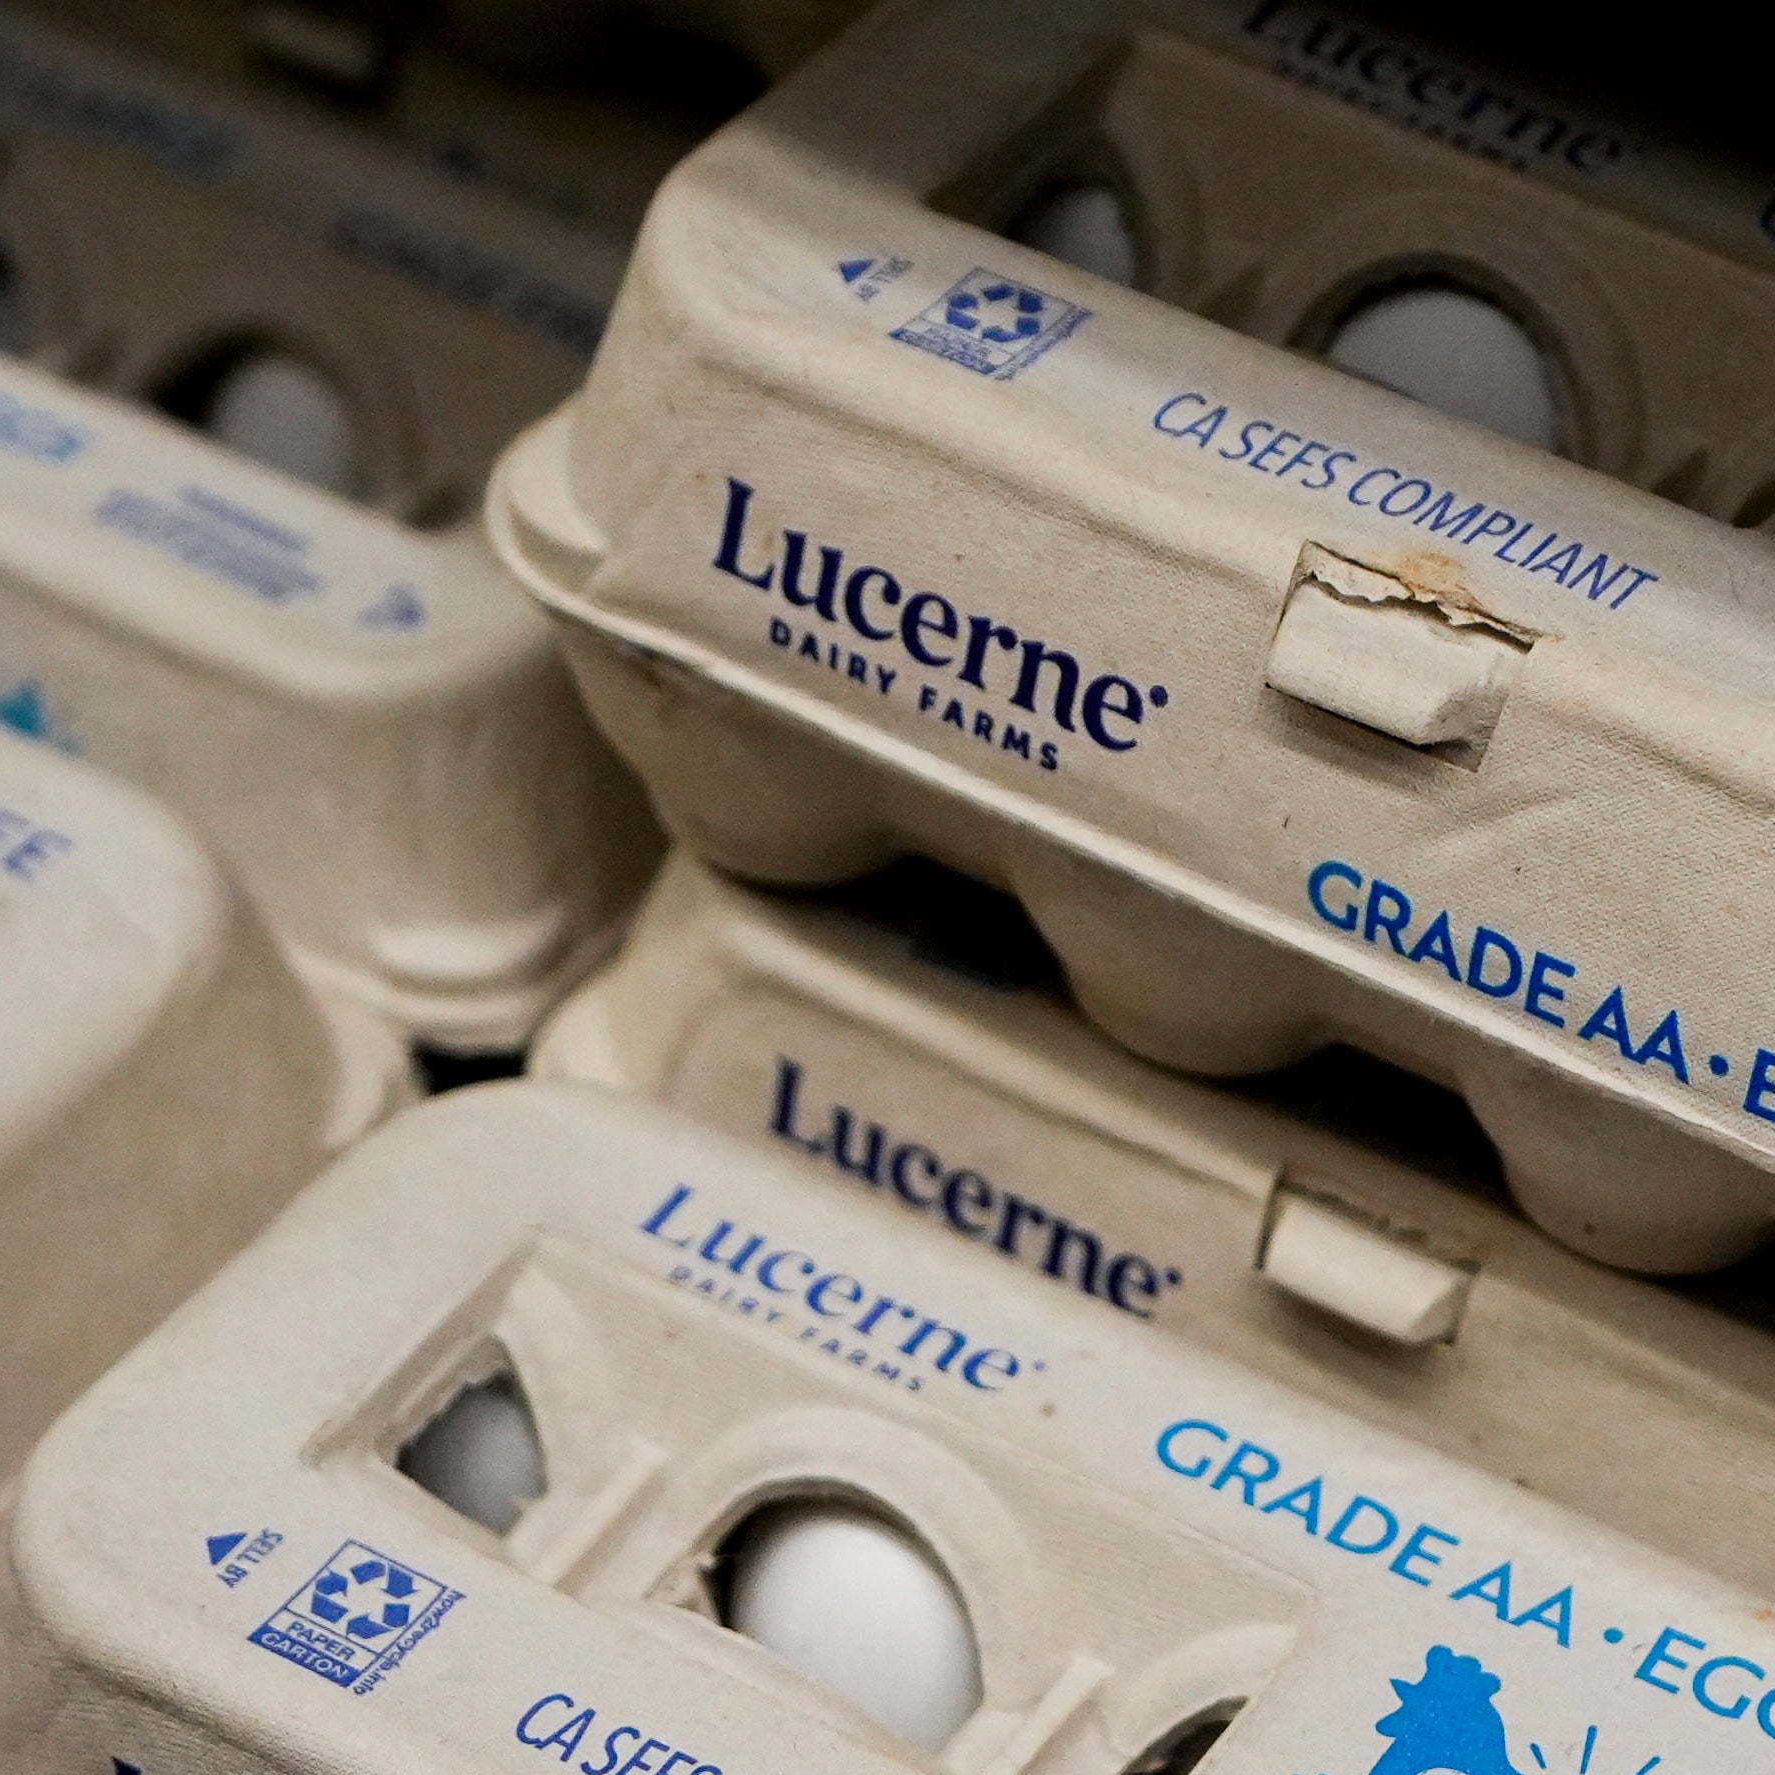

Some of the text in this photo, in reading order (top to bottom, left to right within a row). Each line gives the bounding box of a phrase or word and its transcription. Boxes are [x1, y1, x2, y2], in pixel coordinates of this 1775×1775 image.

[1152, 391, 1659, 611] CA SEFS COMPLIANT
[712, 475, 1145, 754] Lucerne
[768, 614, 1060, 772] DAIRY FARMS
[1307, 860, 1577, 1028] GRADE
[1577, 984, 1691, 1086] AA
[638, 1182, 1021, 1392] Lucerne
[766, 1056, 1161, 1320] Lucerne
[798, 1325, 927, 1393] FARMS
[1155, 1417, 1462, 1588] GRADE
[1448, 1560, 1574, 1649] AA
[260, 1630, 350, 1680] CARTON
[287, 1620, 356, 1662] PAPER
[513, 1692, 588, 1765] CA
